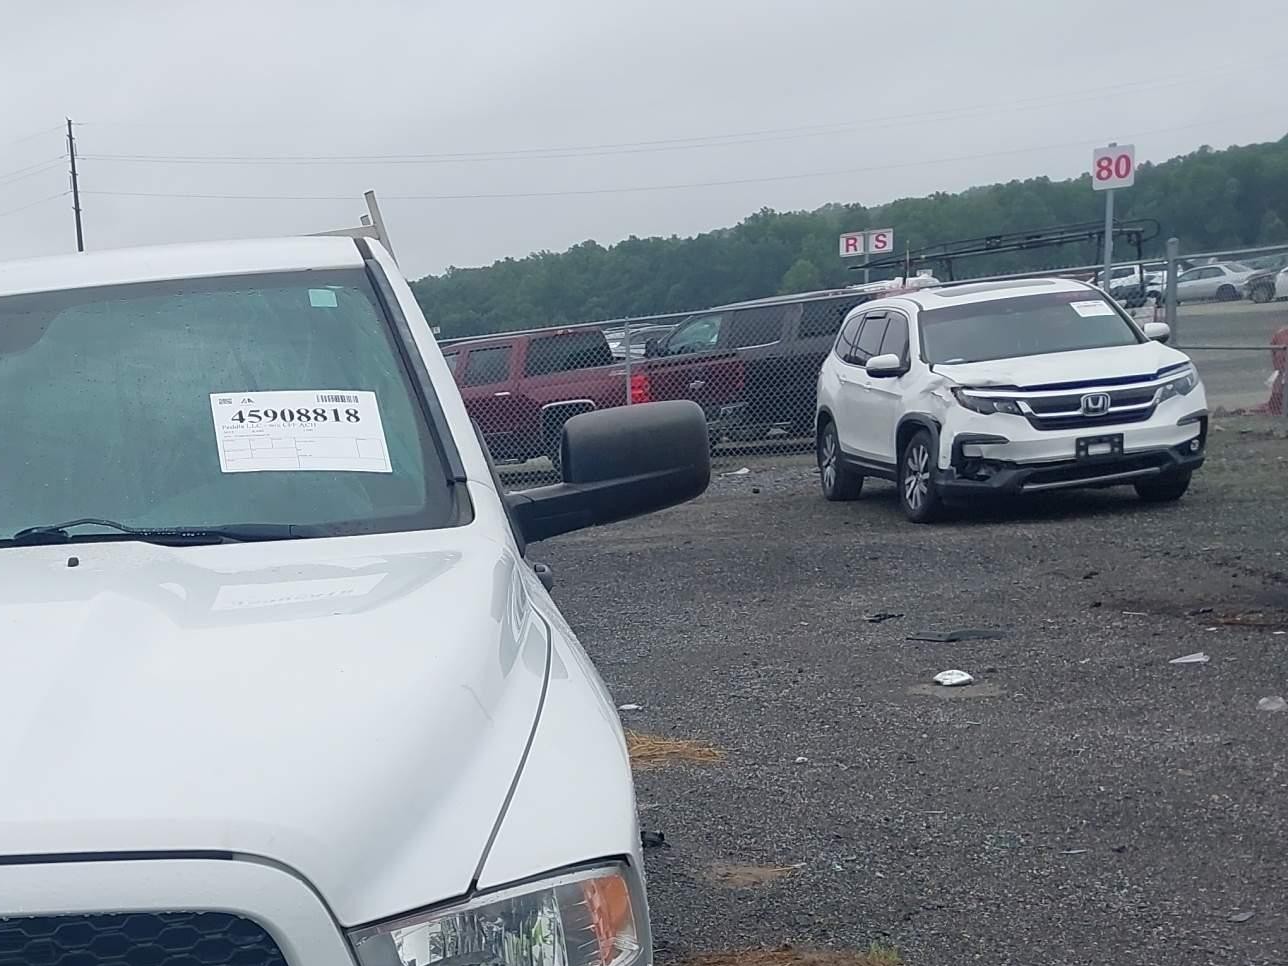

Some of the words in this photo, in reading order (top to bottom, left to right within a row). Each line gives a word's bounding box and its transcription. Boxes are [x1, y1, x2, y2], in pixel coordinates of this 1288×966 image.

[1096, 154, 1131, 180] 80
[845, 236, 858, 253] R
[874, 233, 888, 249] S
[231, 407, 361, 424] 45908818
